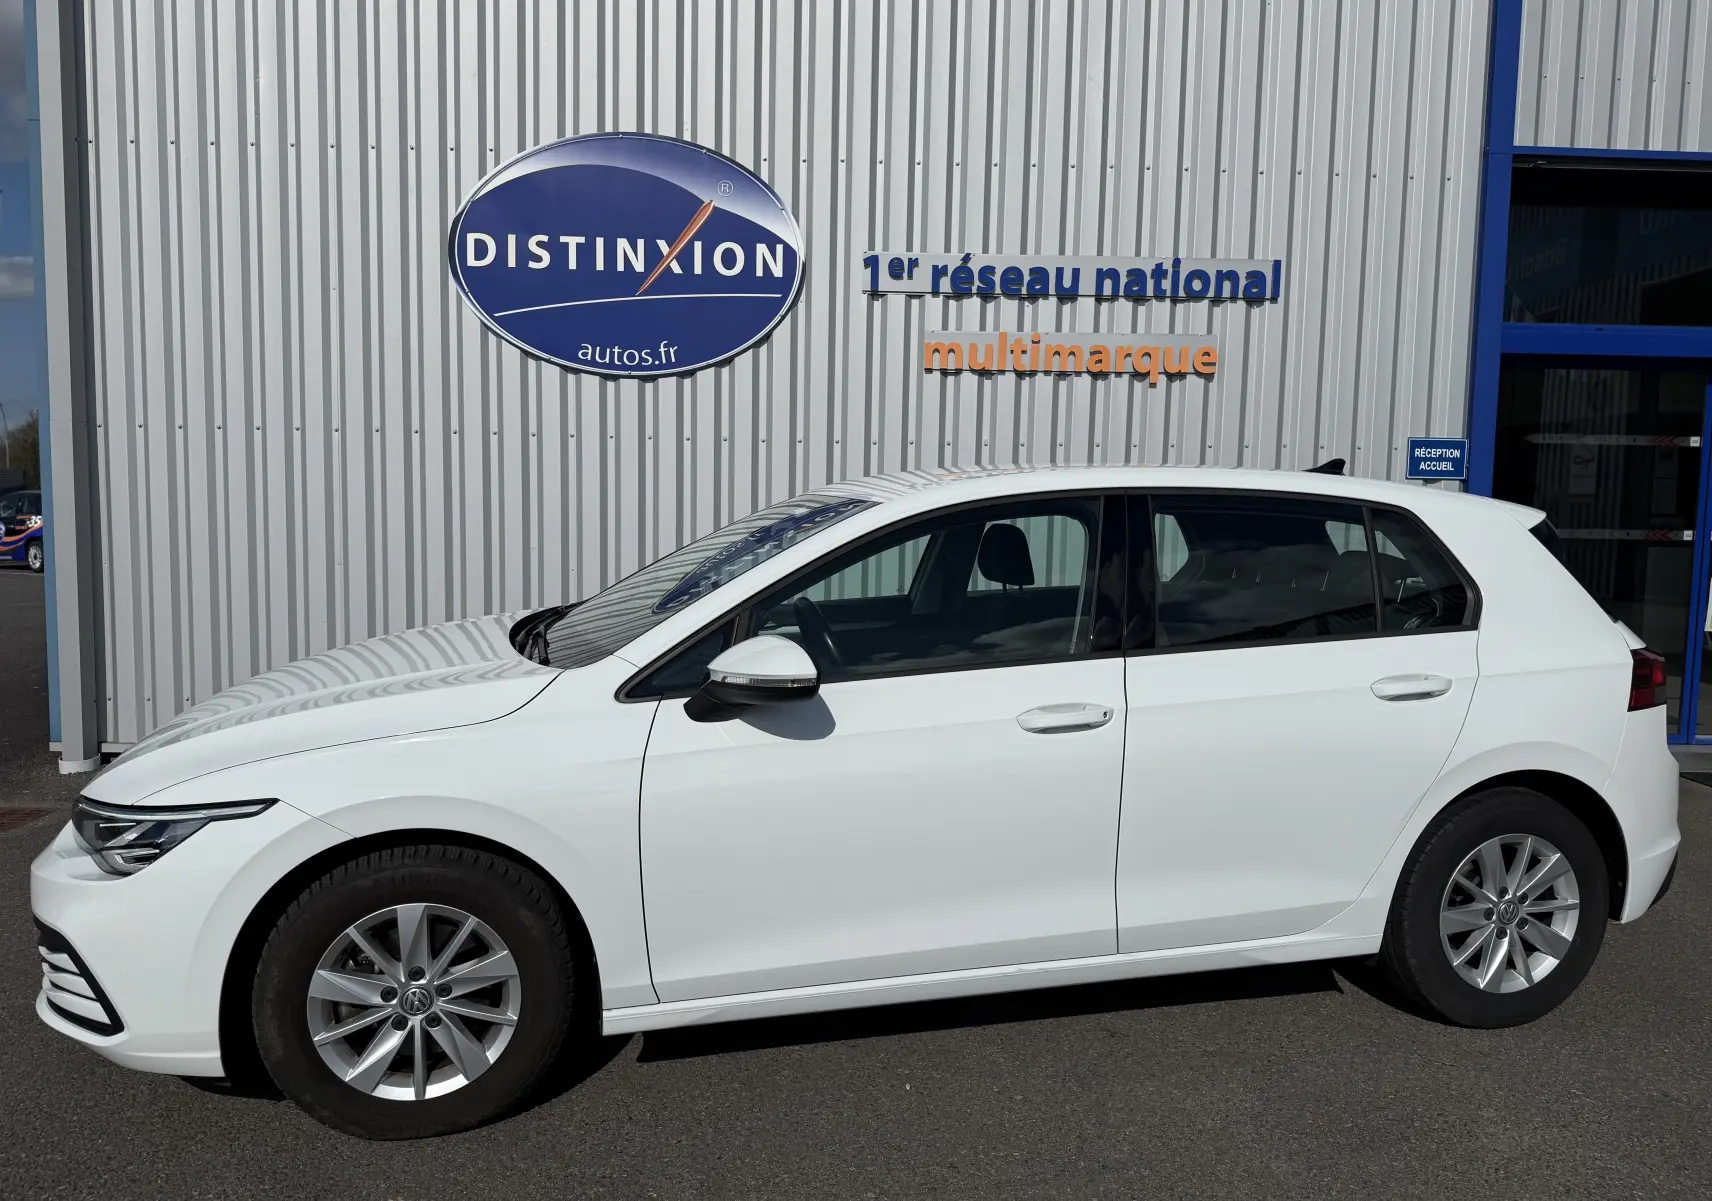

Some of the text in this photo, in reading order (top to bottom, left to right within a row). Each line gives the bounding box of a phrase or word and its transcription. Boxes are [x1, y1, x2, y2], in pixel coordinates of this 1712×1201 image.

[466, 232, 784, 278] DISTINXION
[863, 252, 1282, 301] 1er réseau national
[578, 340, 678, 366] autos.fr
[923, 331, 1218, 384] multimarque
[1414, 446, 1460, 458] RÉCEPTION
[1419, 461, 1455, 471] ACCUEIL
